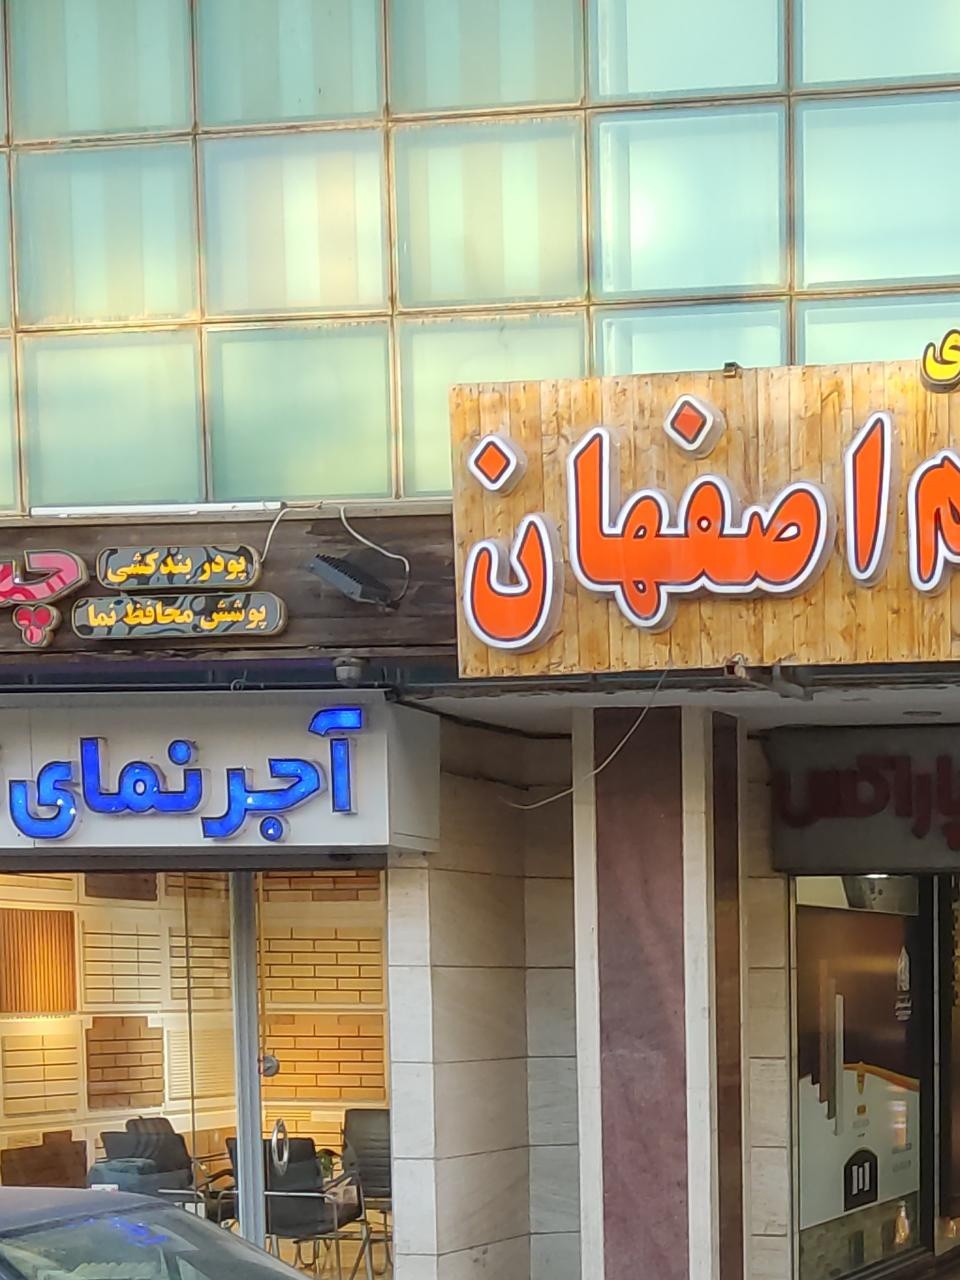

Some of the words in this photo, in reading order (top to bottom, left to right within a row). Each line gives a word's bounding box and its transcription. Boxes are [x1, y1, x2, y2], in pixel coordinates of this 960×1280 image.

[463, 393, 892, 650] اصفهان
[199, 552, 246, 581] پودر
[87, 603, 117, 628] نما
[123, 600, 194, 626] محافظ
[200, 600, 267, 630] پوشش
[8, 736, 204, 840] نمای
[201, 706, 362, 842] آجر
